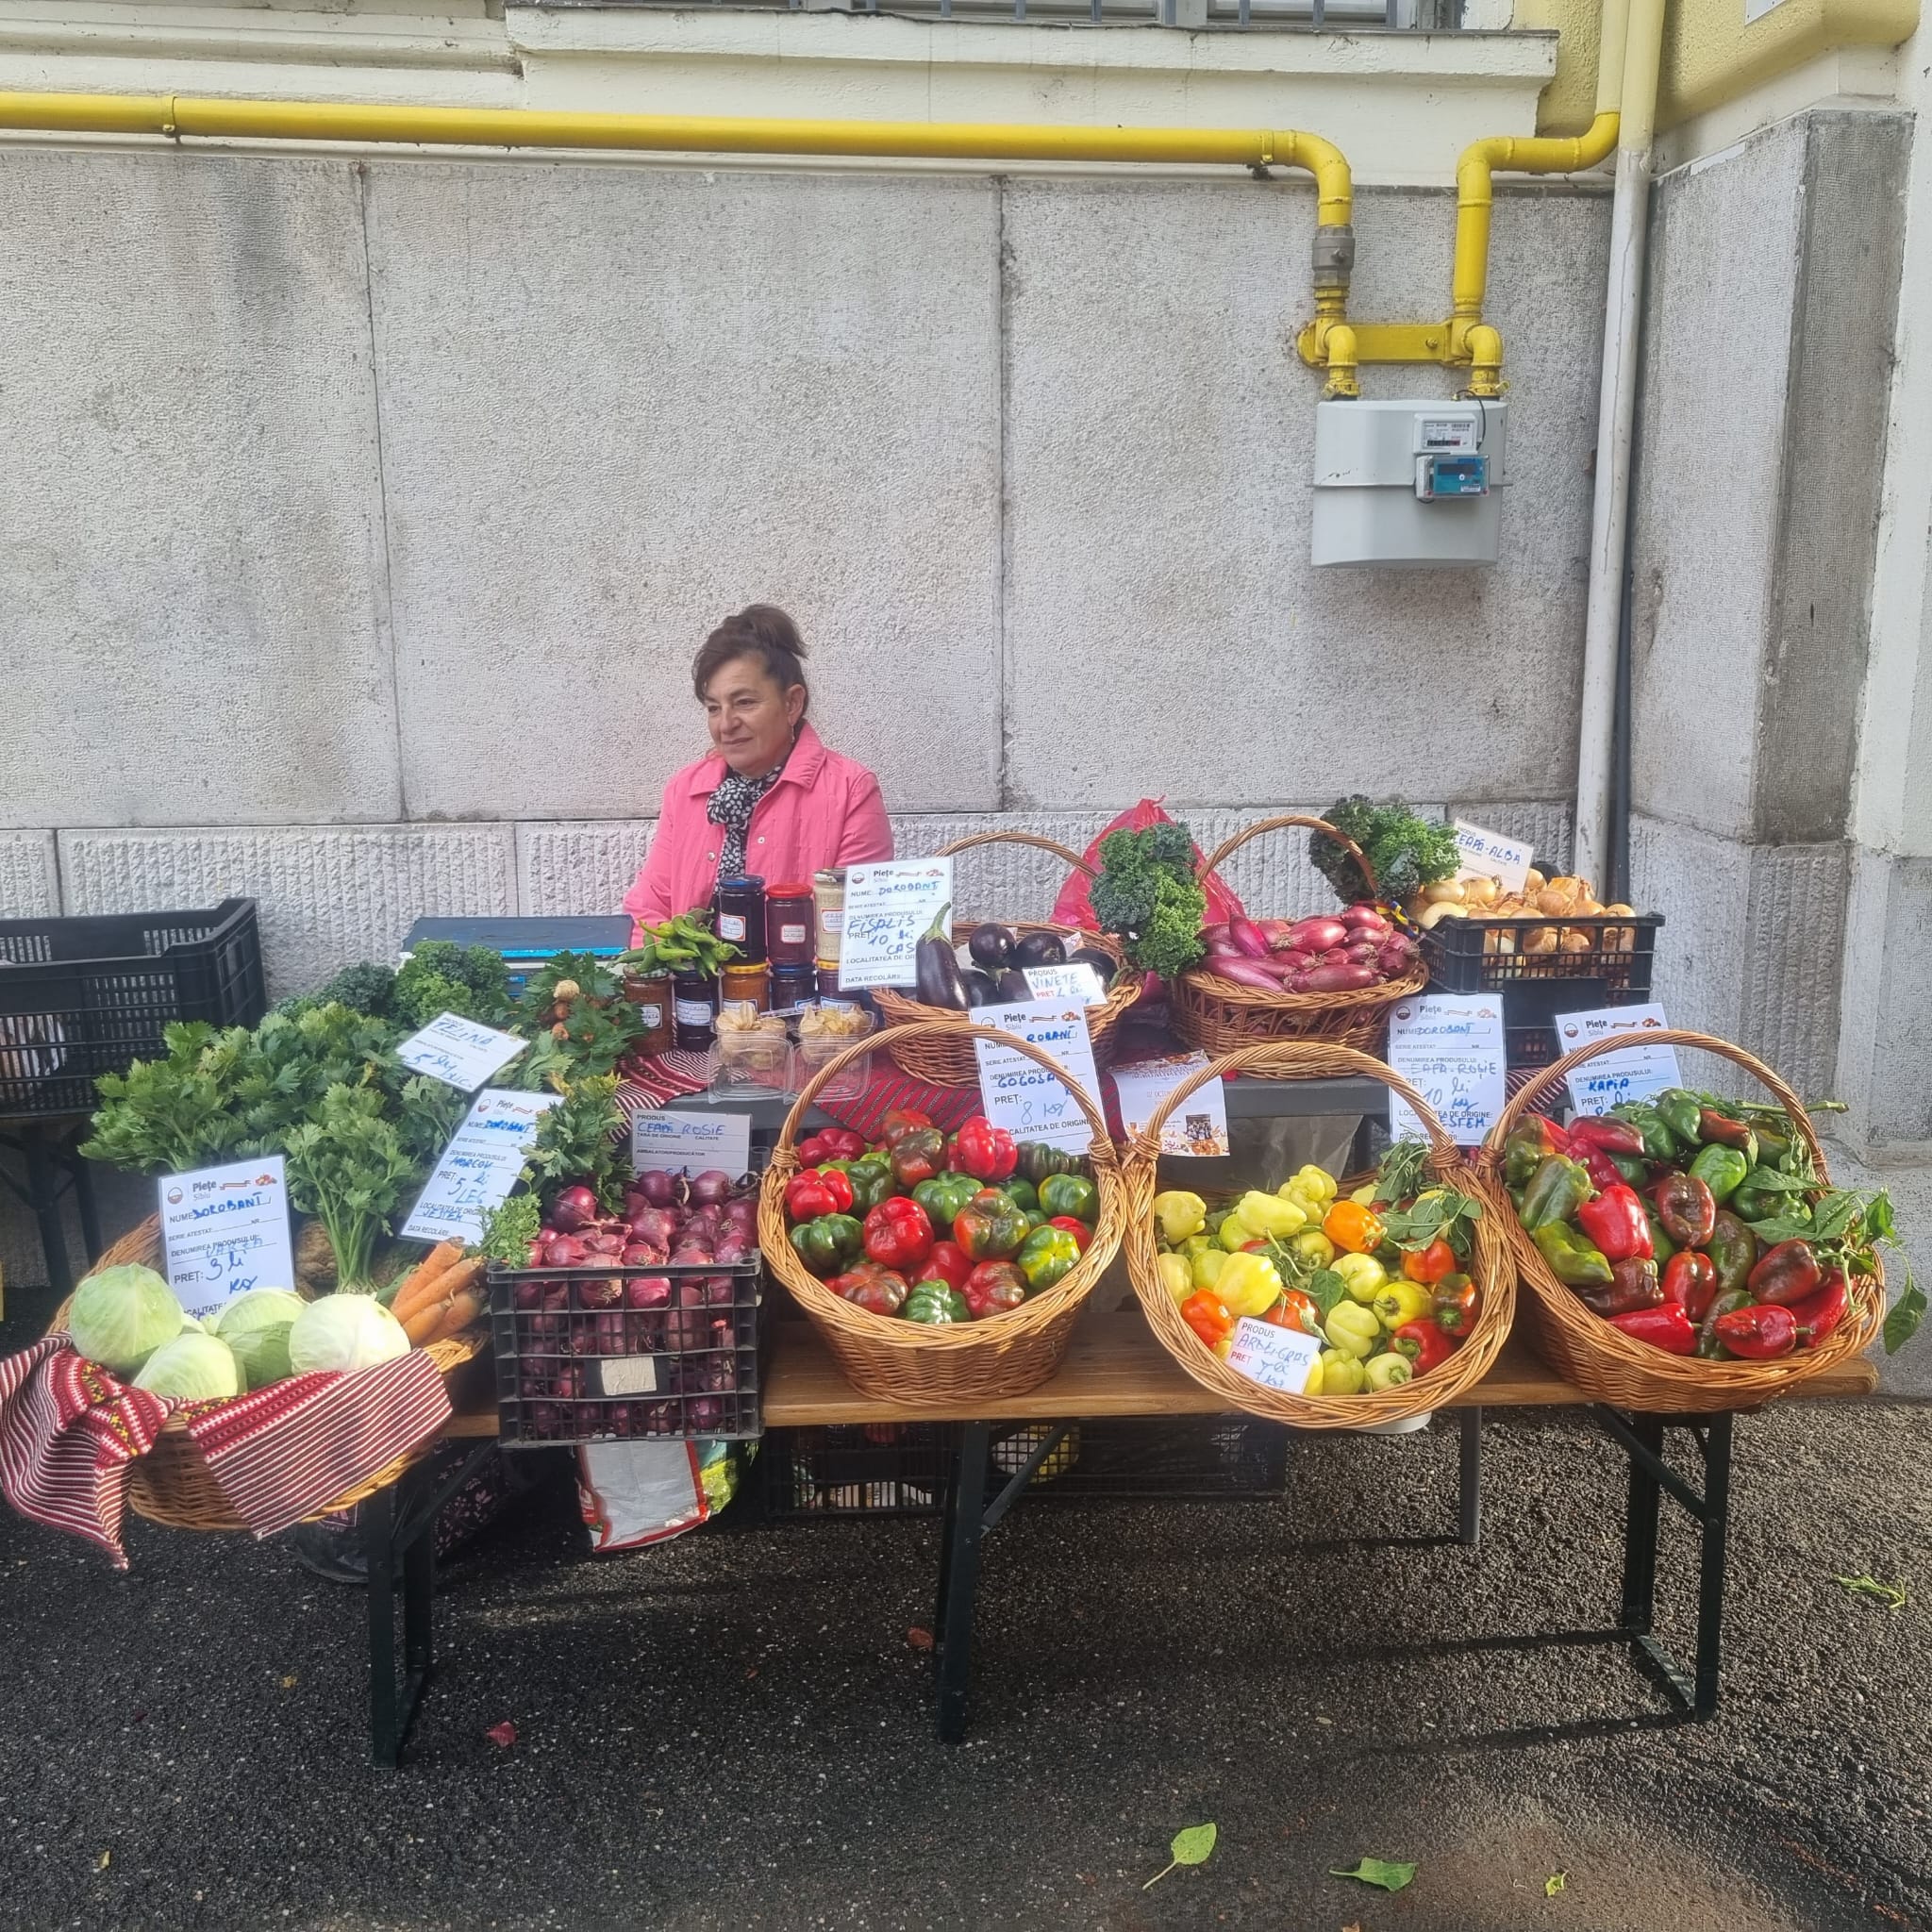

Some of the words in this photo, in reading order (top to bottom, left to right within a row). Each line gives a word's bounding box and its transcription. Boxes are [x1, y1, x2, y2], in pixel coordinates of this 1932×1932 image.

[846, 956, 892, 964] LOCALITATEA
[1032, 973, 1077, 989] VINETE
[990, 1071, 1027, 1080] DENUMIREA
[1575, 1074, 1611, 1083] DENUMIREA
[1022, 1101, 1032, 1124] 8
[1009, 1125, 1048, 1135] CALITATEA
[193, 1192, 211, 1201] Sibiu
[171, 1243, 212, 1257] DENUMIREA
[1241, 1323, 1275, 1338] PRODUS
[1230, 1351, 1253, 1364] PRET
